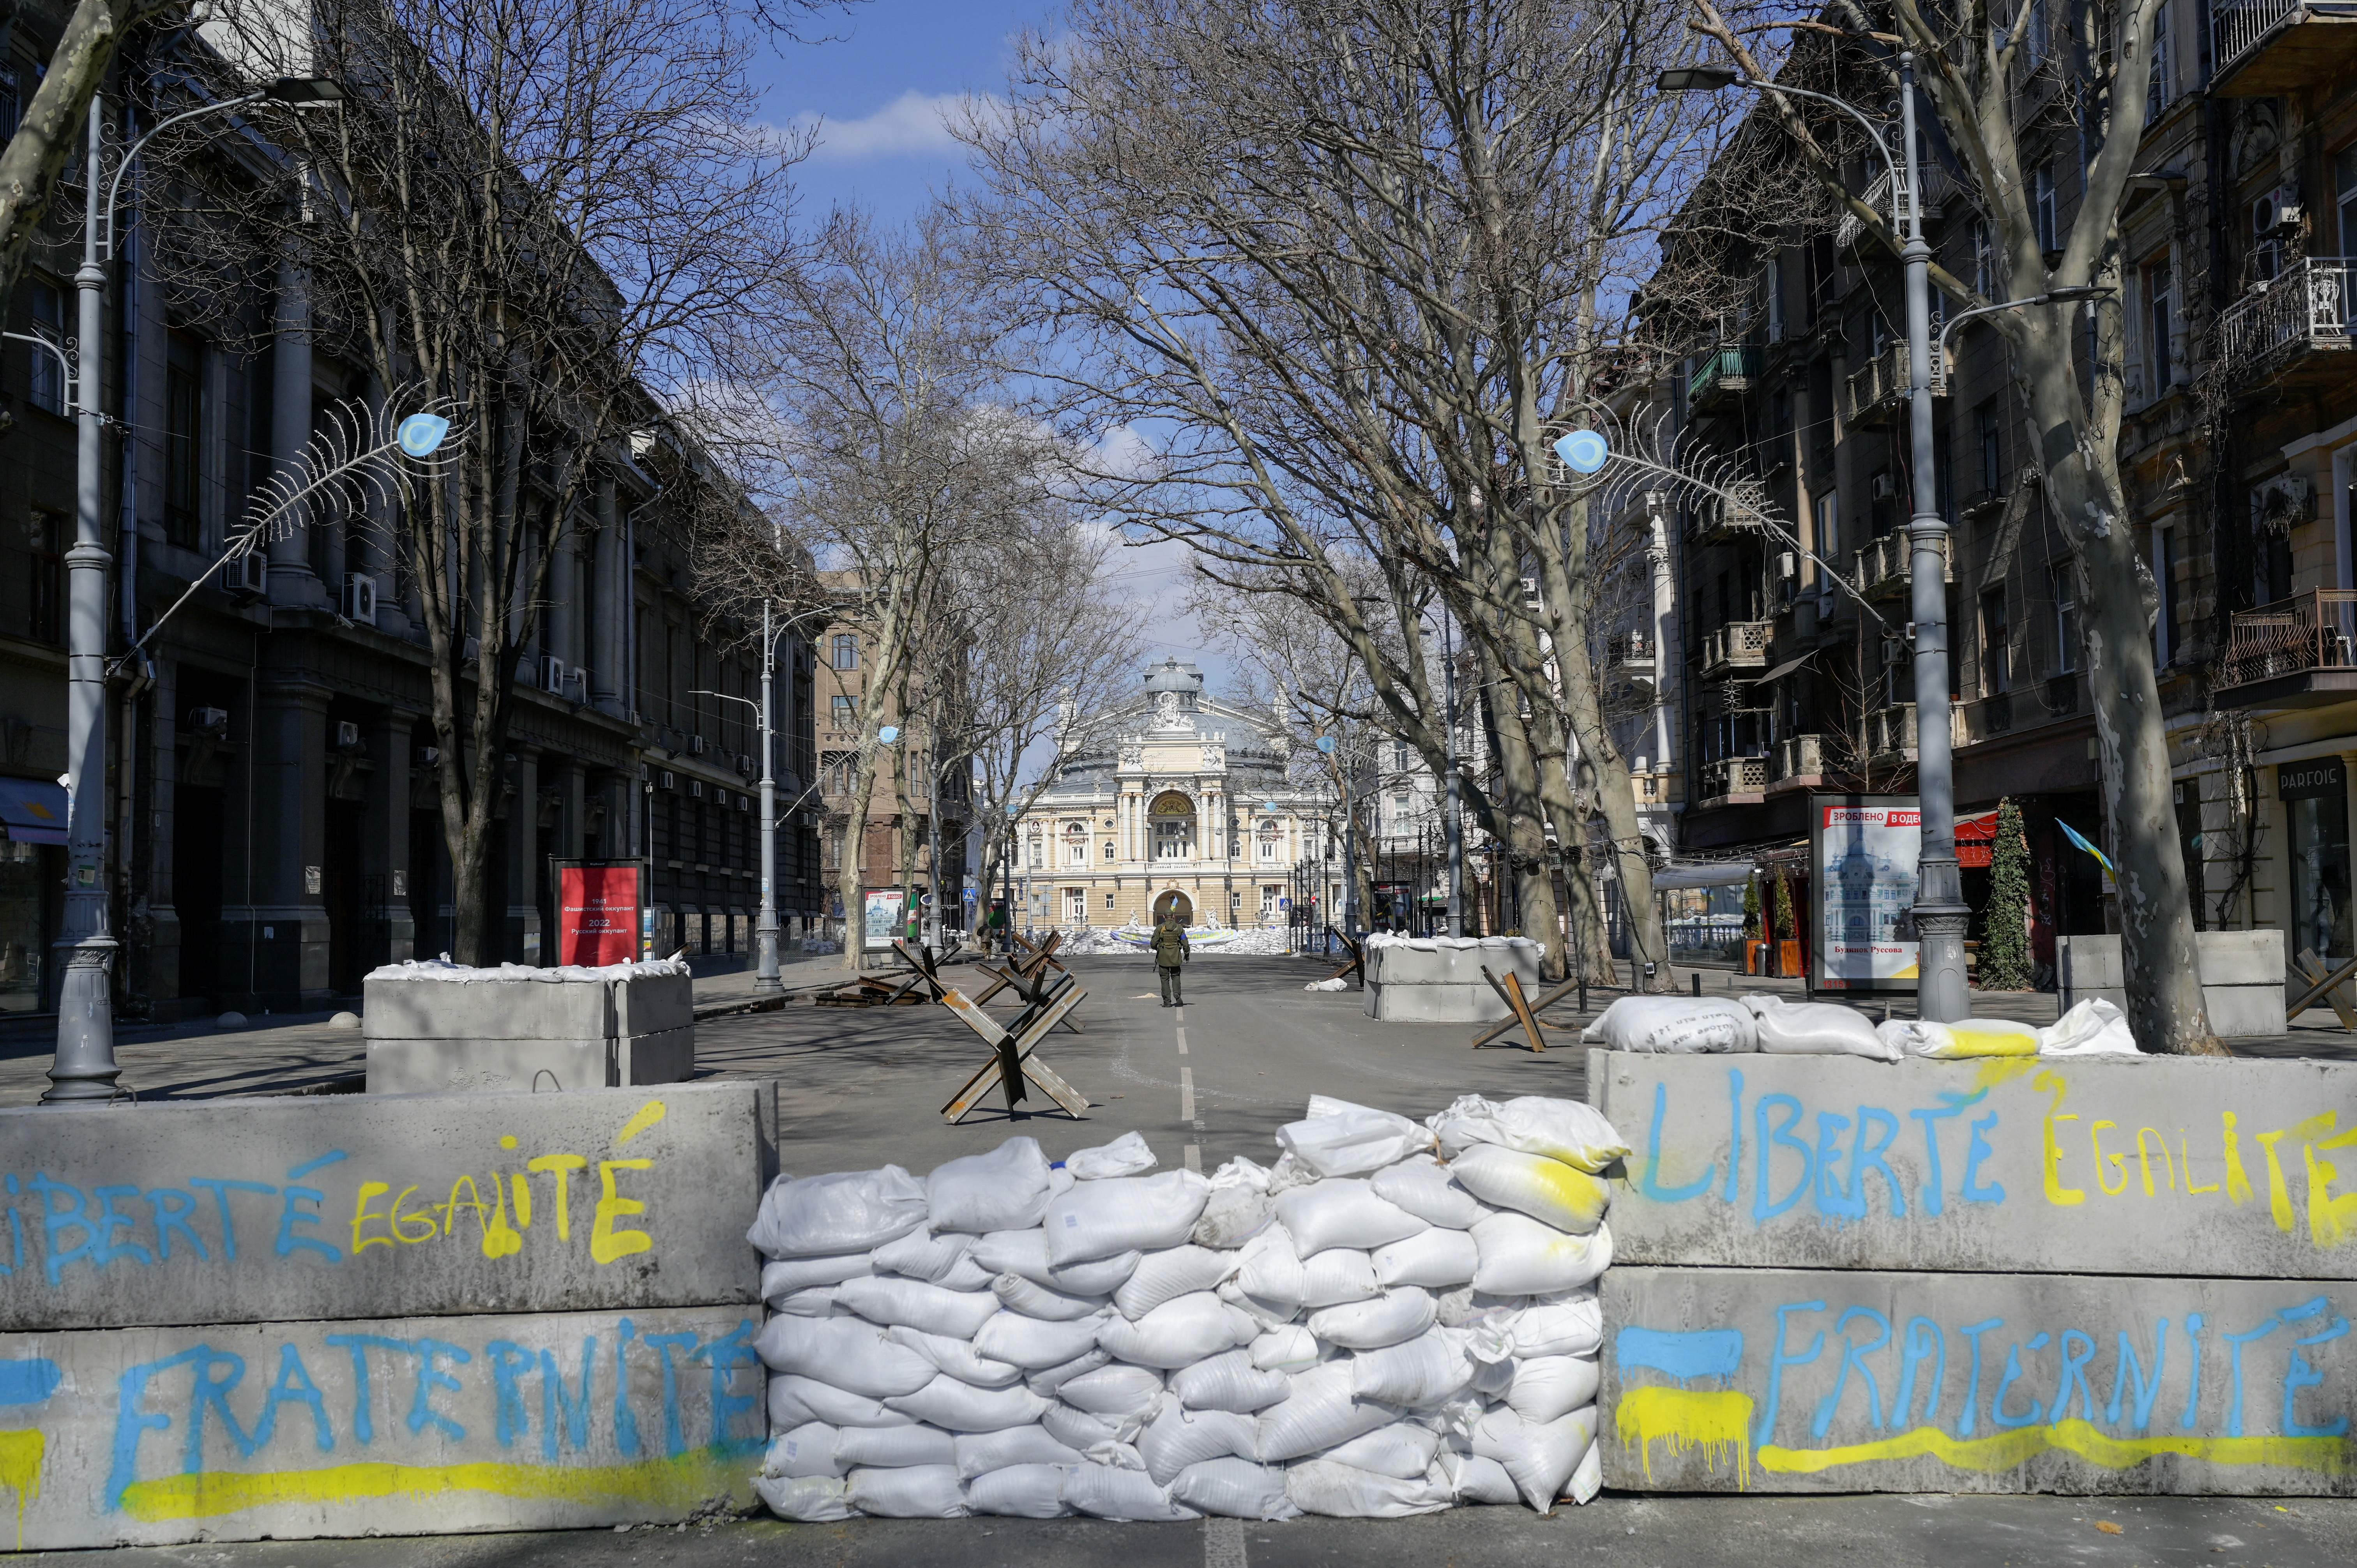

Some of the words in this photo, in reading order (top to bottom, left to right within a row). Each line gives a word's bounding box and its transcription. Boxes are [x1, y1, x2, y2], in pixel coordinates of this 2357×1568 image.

[2281, 768, 2337, 789] PARFOIS
[2177, 788, 2181, 800] 9
[1834, 812, 1883, 821] ЗРОБЛЕНО
[1891, 814, 1897, 823] В
[1642, 1067, 2007, 1231] LIBERTÉ
